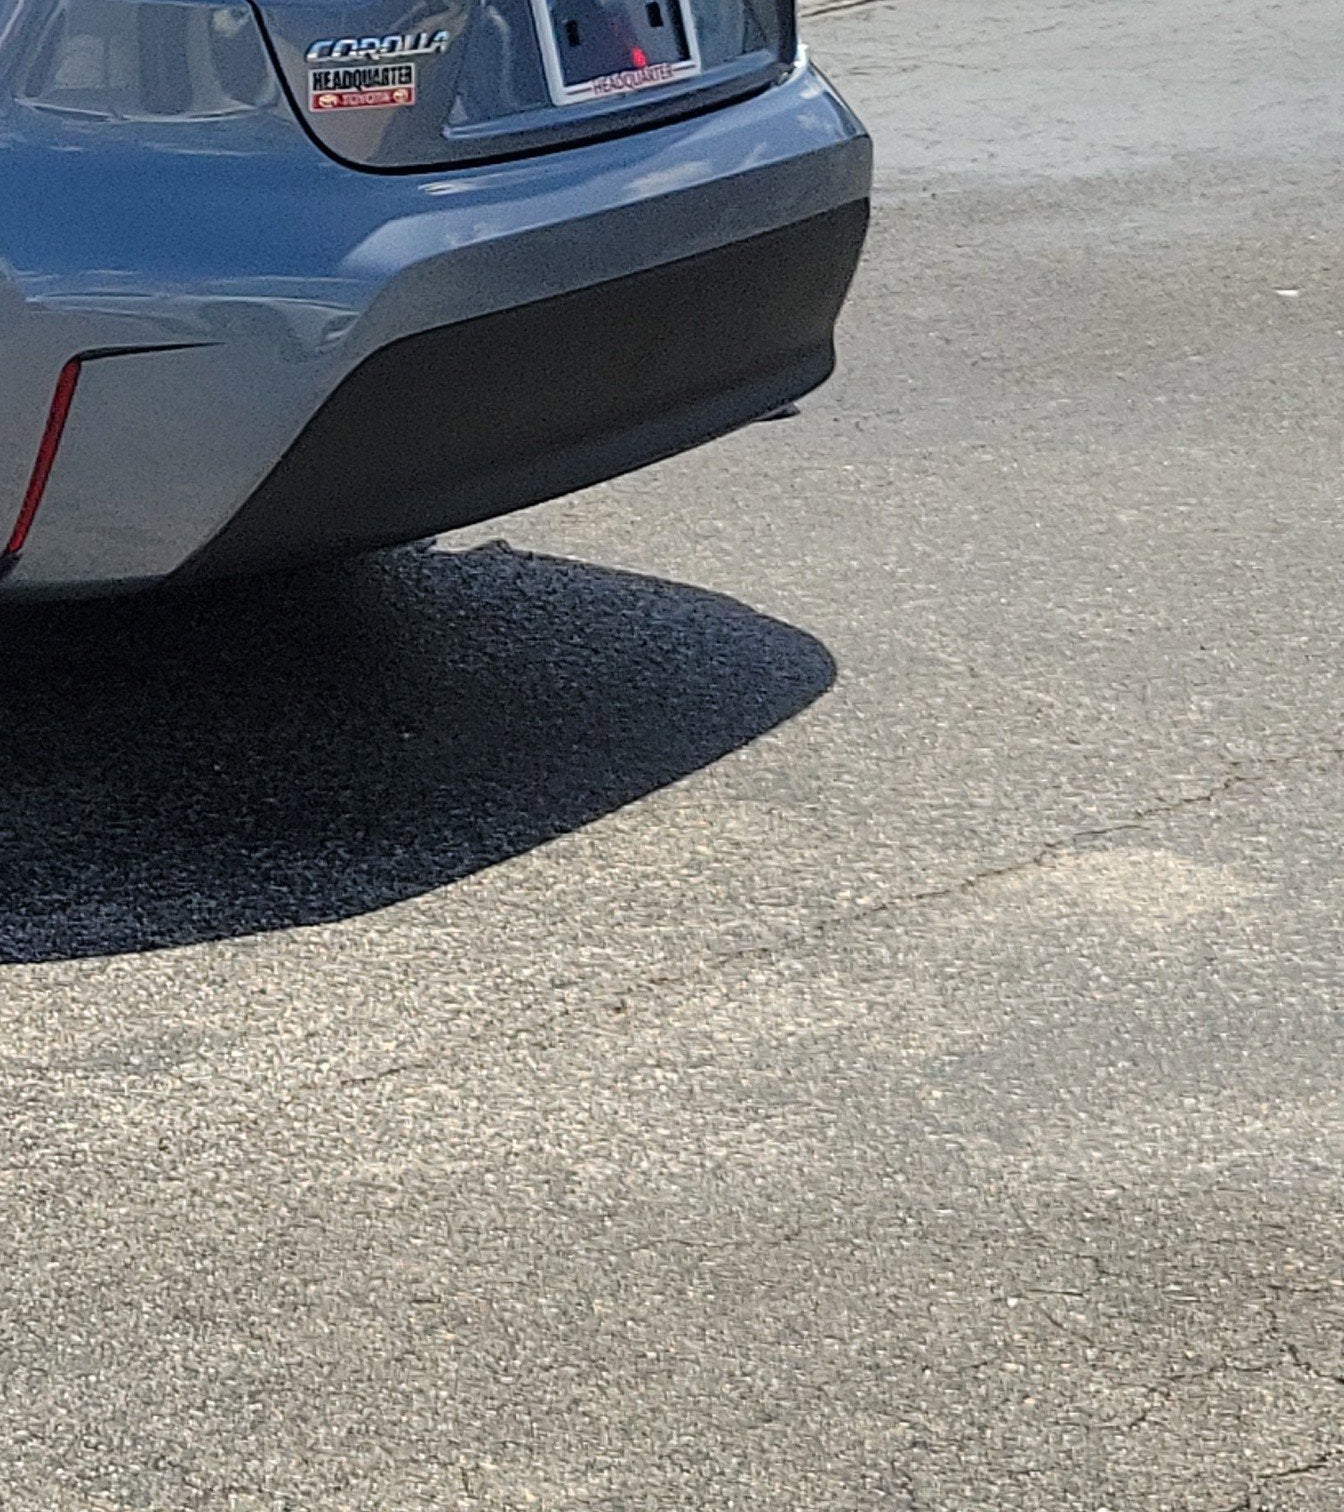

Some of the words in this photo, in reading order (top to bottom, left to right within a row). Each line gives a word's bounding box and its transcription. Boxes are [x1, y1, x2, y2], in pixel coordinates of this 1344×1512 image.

[305, 29, 450, 62] COROLLA
[312, 65, 412, 92] HEADQUARTER
[593, 63, 673, 96] HEADQUARTER
